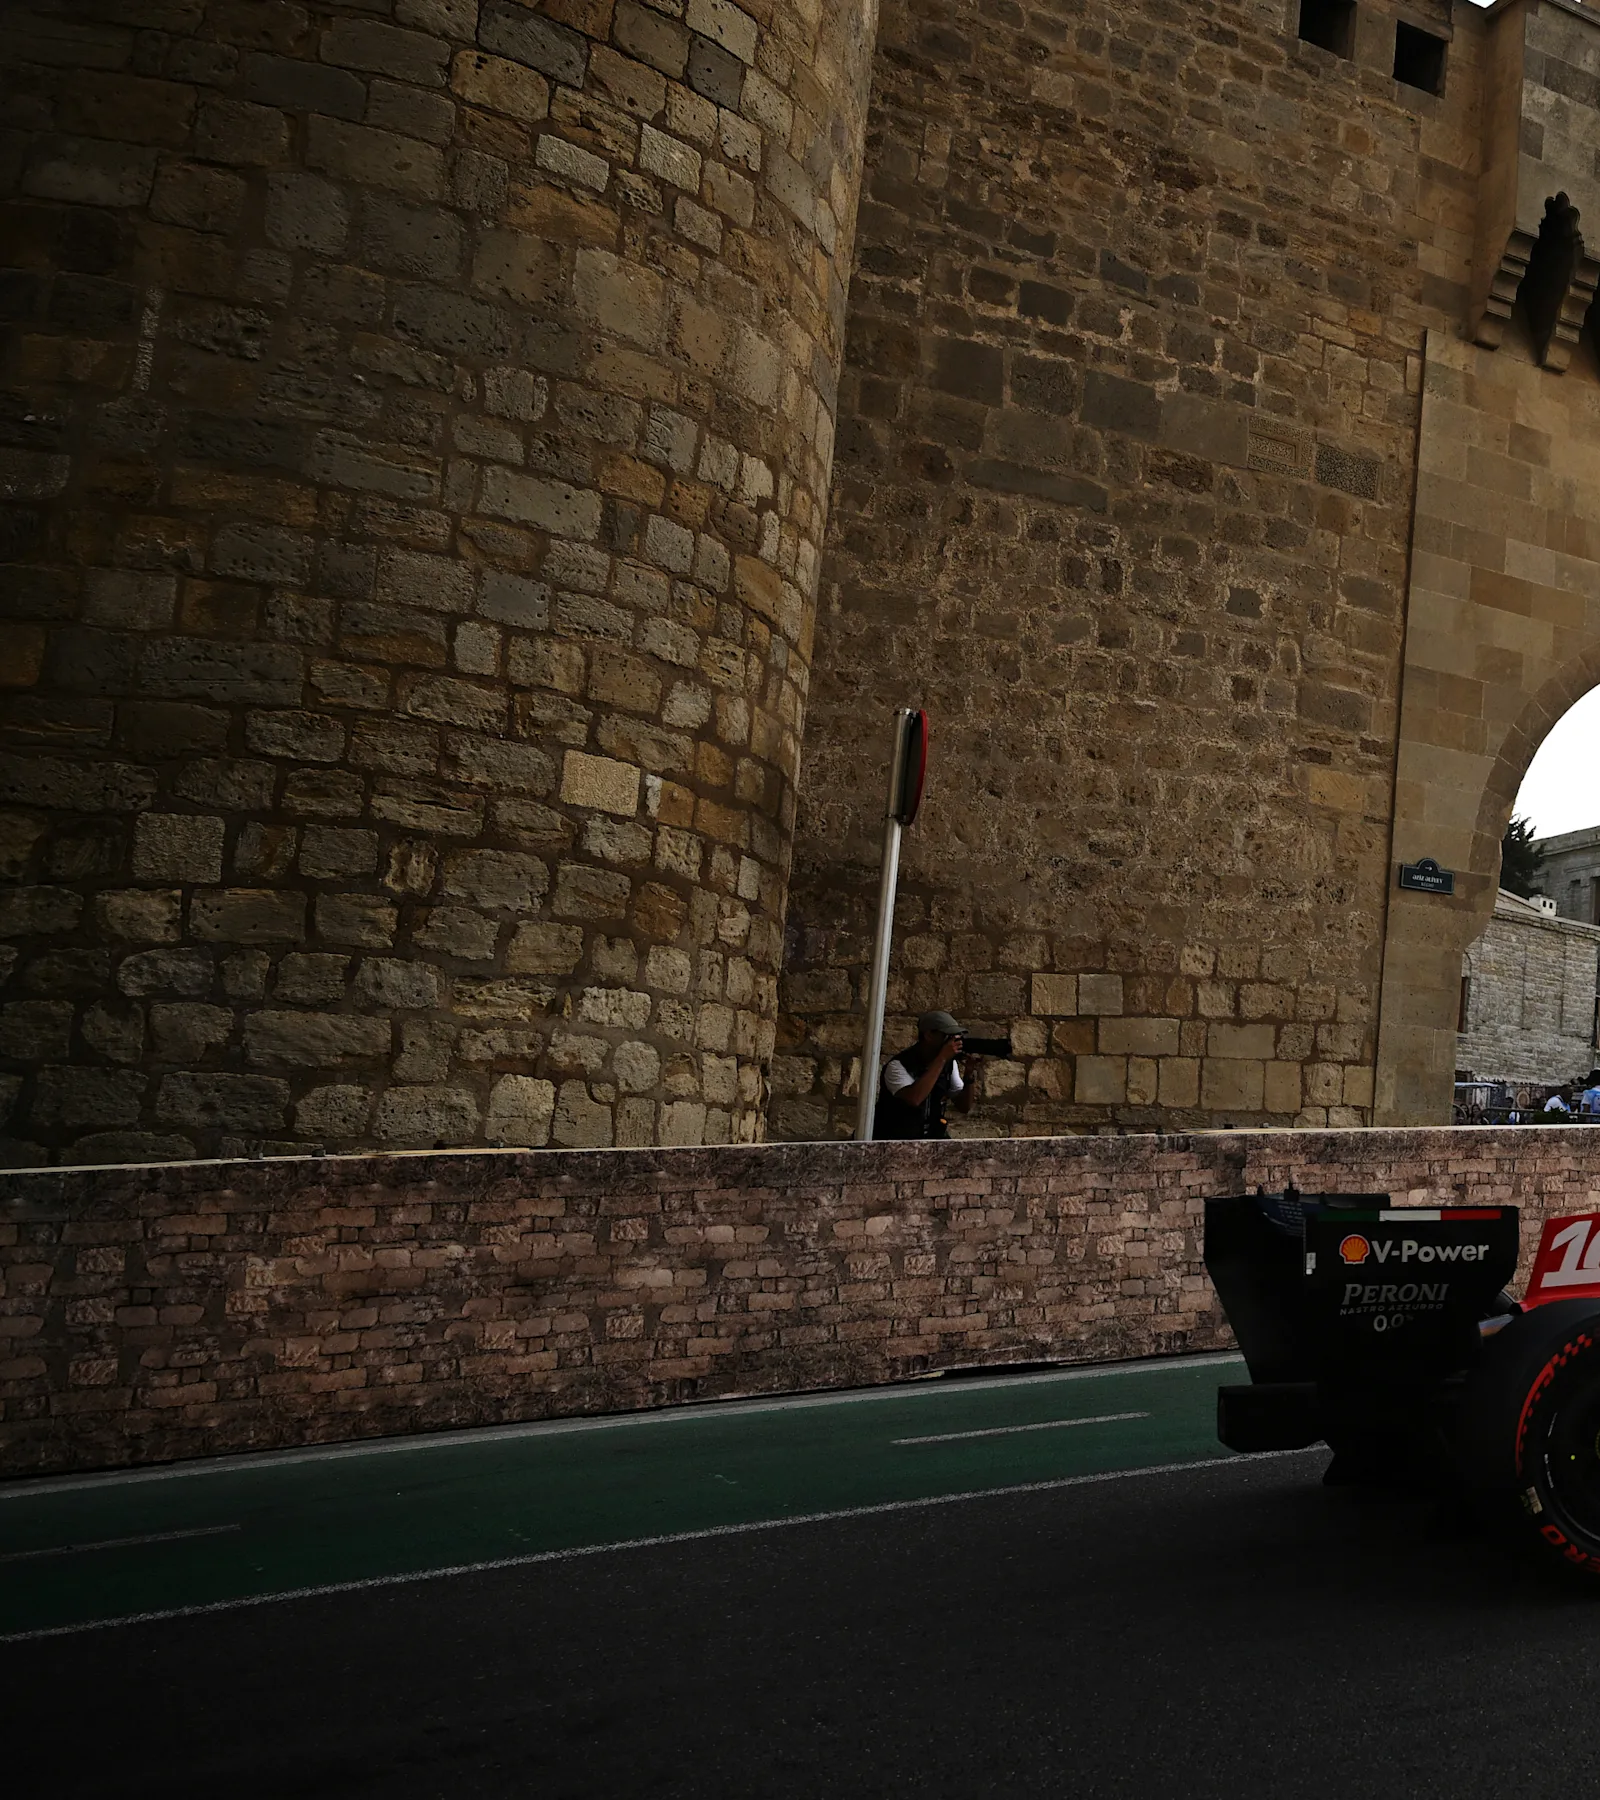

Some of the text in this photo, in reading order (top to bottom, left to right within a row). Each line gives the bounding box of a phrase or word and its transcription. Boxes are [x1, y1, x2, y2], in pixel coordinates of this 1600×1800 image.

[1371, 1239, 1490, 1264] V-Power
[1341, 1282, 1450, 1306] PERONI
[1339, 1304, 1386, 1316] NASTRO
